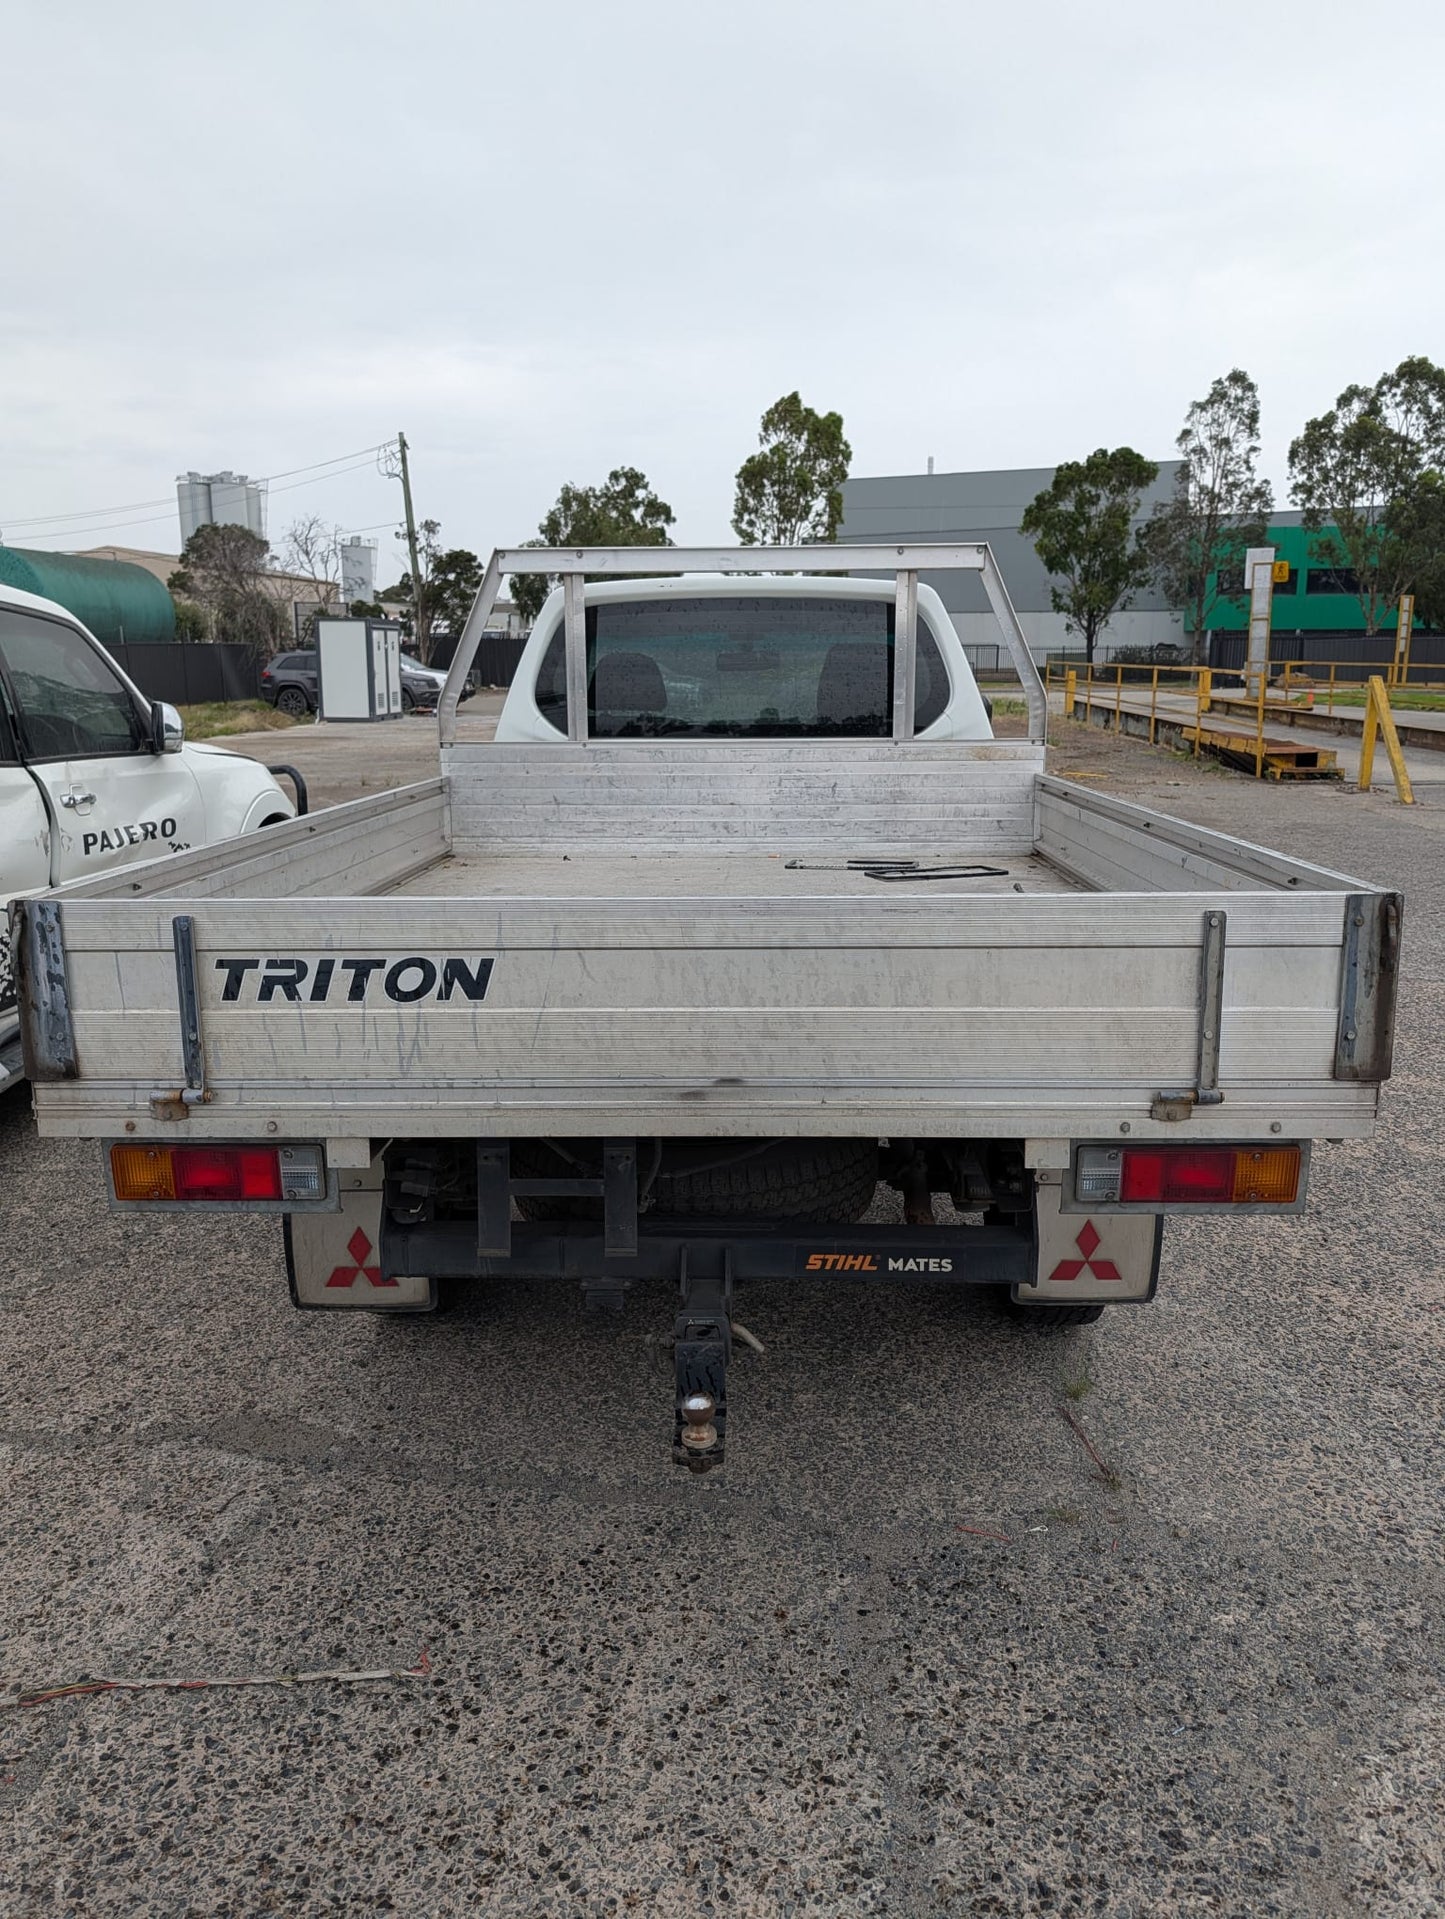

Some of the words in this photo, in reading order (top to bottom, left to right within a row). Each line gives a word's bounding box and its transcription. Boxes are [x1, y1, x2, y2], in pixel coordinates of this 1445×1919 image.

[82, 817, 177, 856] PAJERO
[214, 956, 496, 1003] TRITON
[805, 1254, 878, 1271] STIHL
[888, 1257, 953, 1272] MATES
